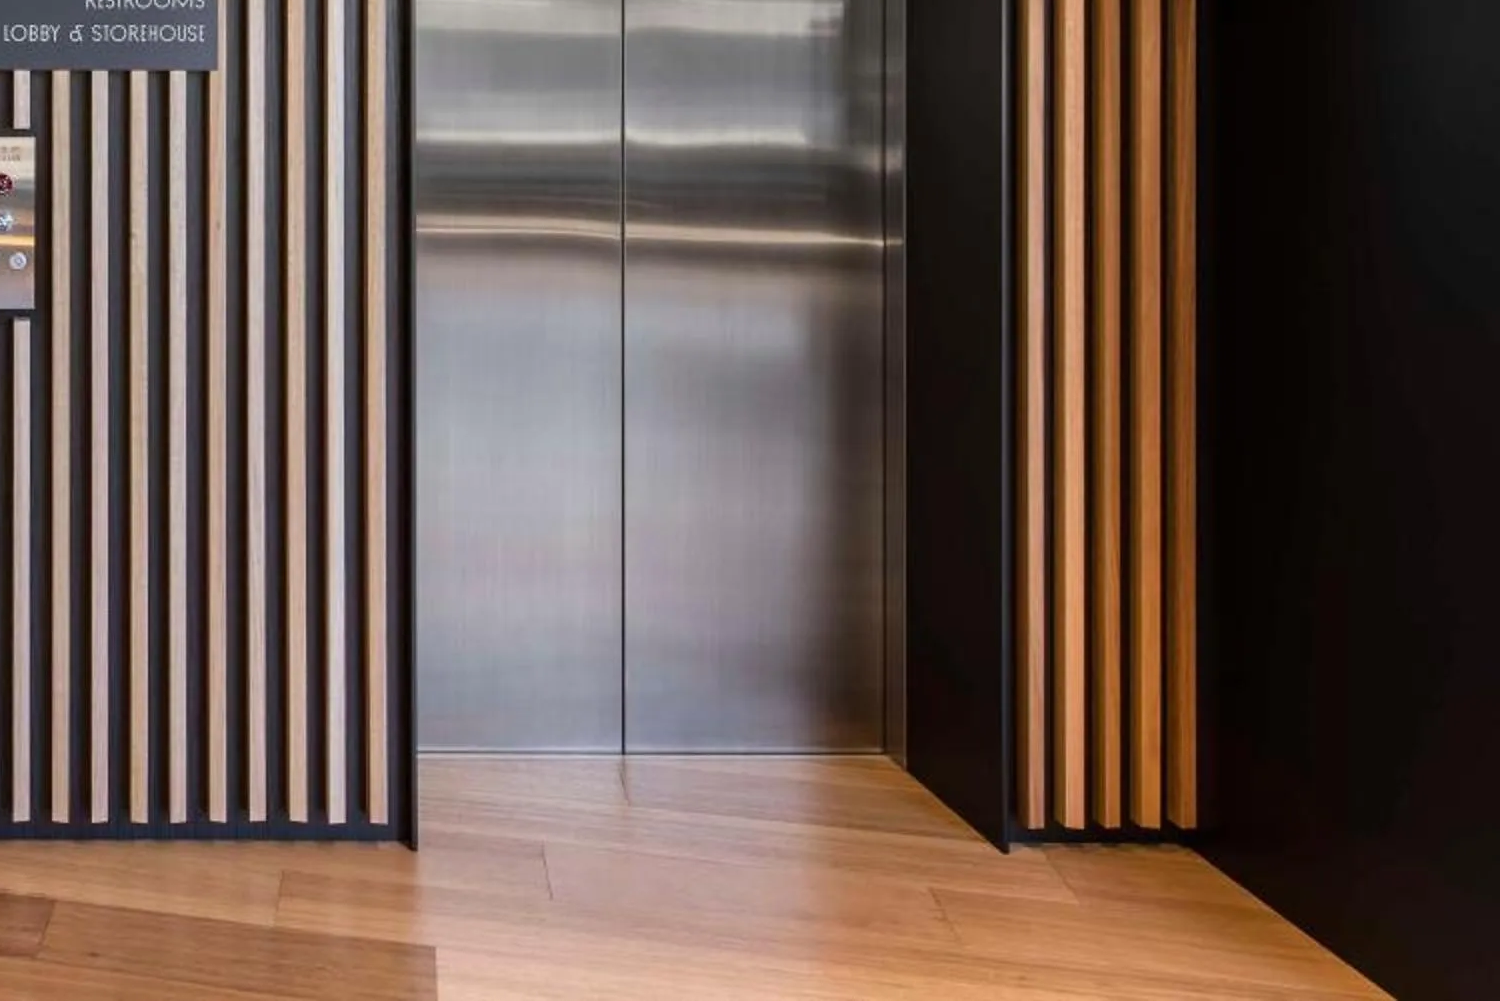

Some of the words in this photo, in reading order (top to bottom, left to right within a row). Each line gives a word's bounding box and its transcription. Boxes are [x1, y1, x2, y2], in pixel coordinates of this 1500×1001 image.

[4, 24, 61, 42] LOBBY
[69, 25, 85, 42] &
[91, 24, 206, 42] STOREHOUSE
